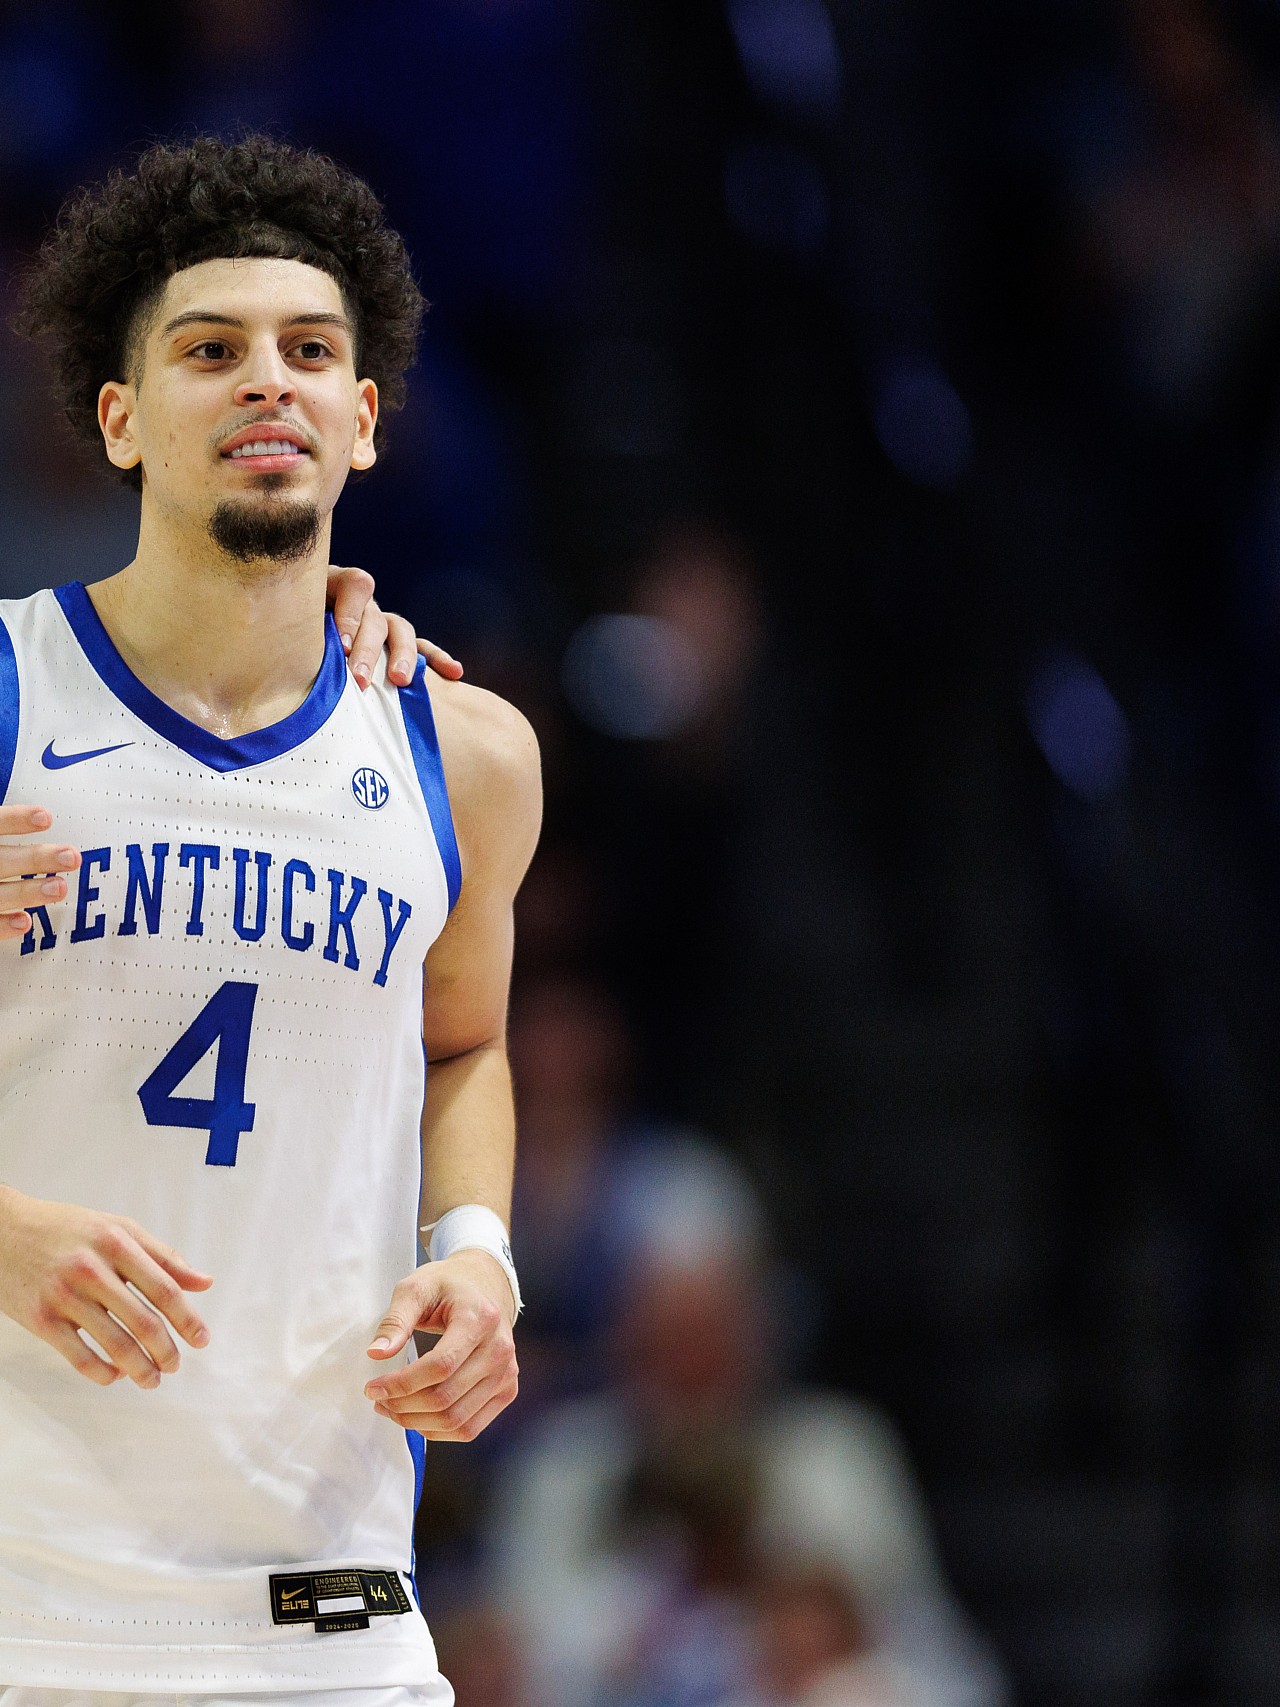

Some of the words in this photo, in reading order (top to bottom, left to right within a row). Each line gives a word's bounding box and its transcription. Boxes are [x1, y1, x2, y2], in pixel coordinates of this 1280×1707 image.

[353, 768, 389, 810] SEC
[137, 981, 258, 1167] 4
[314, 1576, 358, 1586] ENGINEERED
[370, 1585, 387, 1602] 44
[282, 1600, 309, 1610] ELITE
